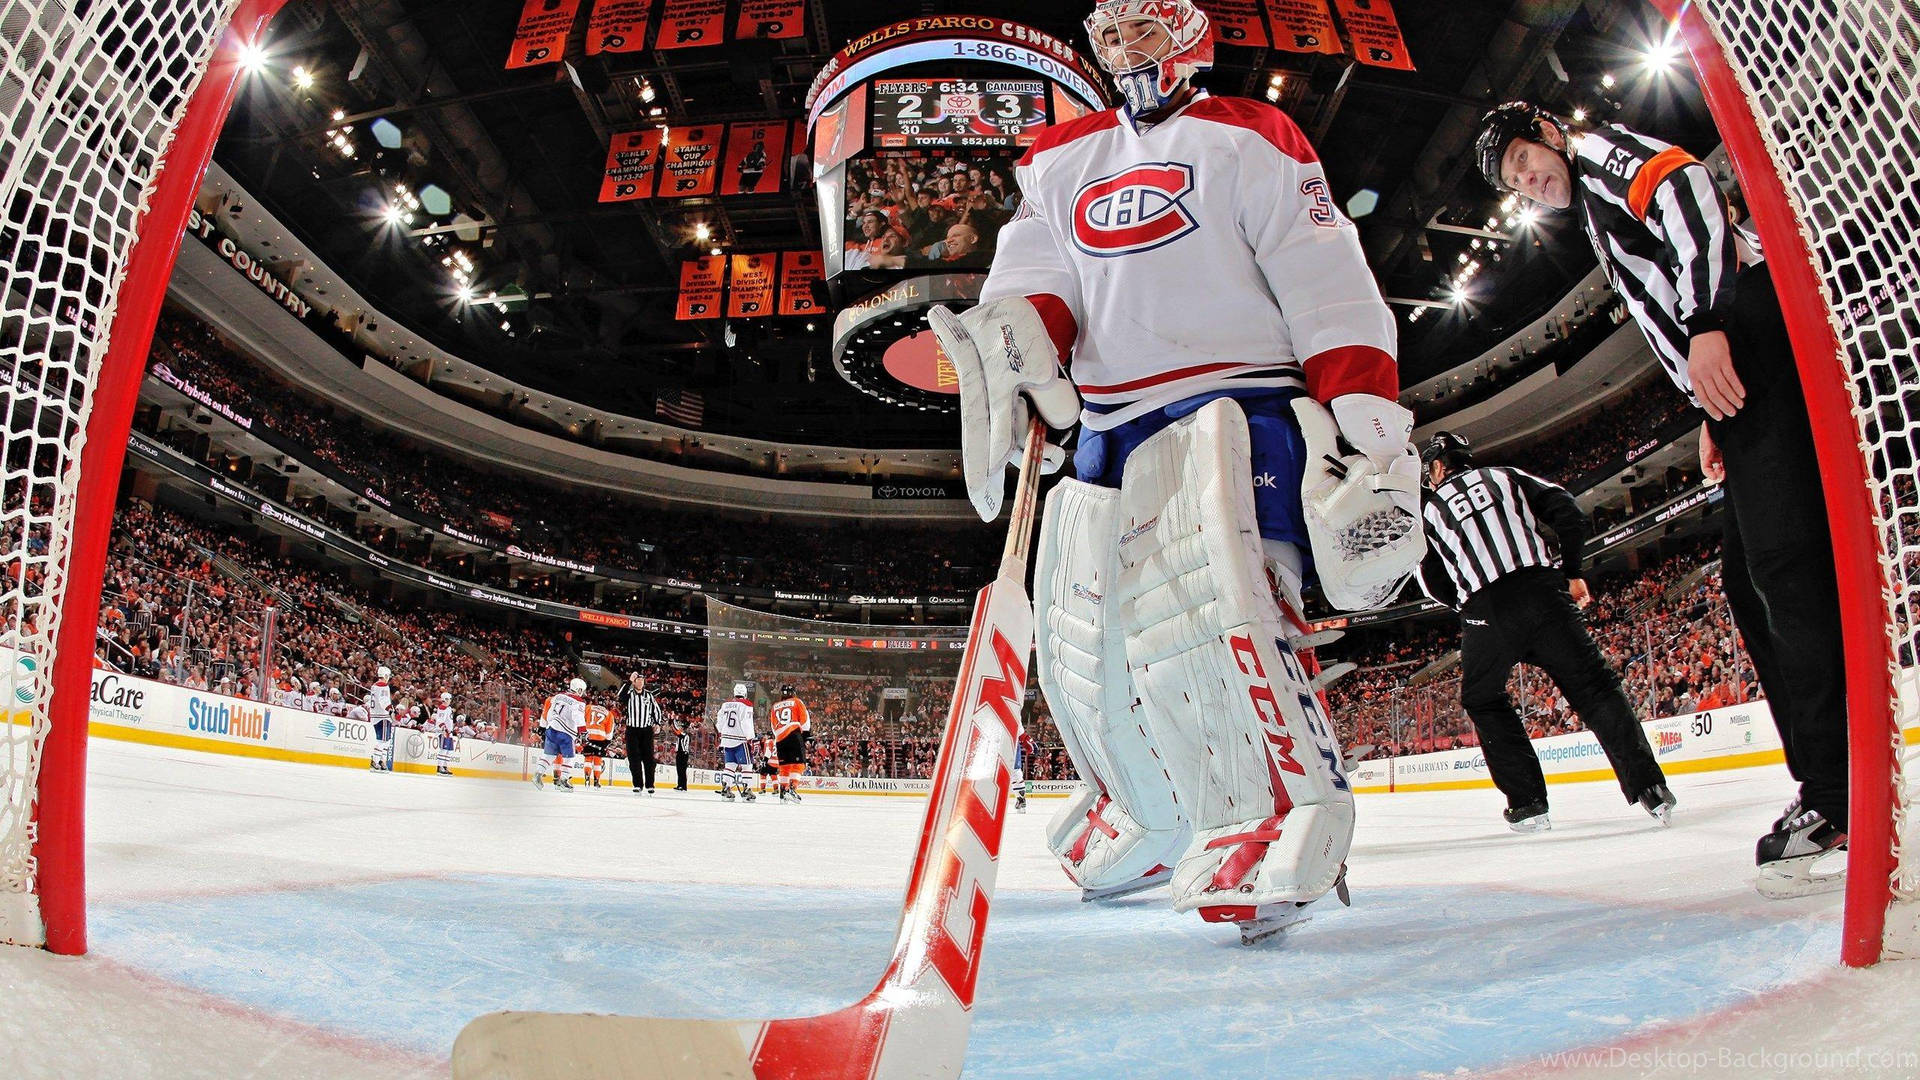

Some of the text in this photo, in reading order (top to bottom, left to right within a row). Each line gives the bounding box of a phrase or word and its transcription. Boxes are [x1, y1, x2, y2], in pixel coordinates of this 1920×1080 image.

[842, 17, 1075, 62] WELLS FARGO CENTER
[878, 81, 1044, 94] FLYERS 6:34 CANADIENS
[897, 95, 1022, 119] 2 3
[752, 128, 765, 140] 16
[900, 125, 1021, 135] 30 3 16
[915, 137, 952, 145] TOTAL
[961, 137, 1007, 146] $52,650
[615, 149, 652, 160] STANLEY
[673, 144, 713, 154] STANLEY
[683, 152, 701, 160] CUP
[622, 157, 640, 166] CUP
[665, 159, 715, 169] CHAMPIONS
[1605, 146, 1632, 176] 24
[605, 163, 655, 176] CHAMPIONS
[219, 238, 313, 319] COUNTRY
[742, 271, 764, 279] WEST
[679, 287, 721, 295] CHAMPIONS
[731, 284, 773, 293] CHAMPIONS
[848, 284, 920, 322] COLONIAL
[183, 380, 253, 429] hybrids on the road
[1371, 417, 1386, 439] PRICE
[136, 442, 159, 457] LEXUS
[1634, 438, 1659, 455] LEXUS
[900, 487, 946, 497] TOYOTA
[372, 493, 392, 507] LEXUS
[1447, 483, 1494, 521] 68
[443, 524, 458, 538] Have
[458, 531, 473, 542] more
[531, 552, 595, 574] hybrids on the road
[677, 581, 702, 589] LEXUS
[775, 591, 793, 599] Have
[900, 597, 918, 605] road
[581, 612, 629, 626] WELLS FARGO
[888, 641, 913, 649] FLYERS
[90, 675, 145, 710] aCare
[1229, 633, 1307, 776] CCM
[115, 709, 142, 724] Therapy
[188, 697, 272, 741] StubHub!
[724, 711, 737, 728] 76
[775, 708, 793, 727] 19
[1275, 636, 1350, 792] CCM
[338, 721, 368, 742] PECO
[1690, 712, 1712, 737] $50
[1660, 731, 1683, 746] MEGA
[486, 753, 506, 762] verizon
[1406, 761, 1449, 774] US AIRWAYS
[1453, 760, 1471, 770] BUD
[848, 779, 898, 790] JACK DANIEL'S
